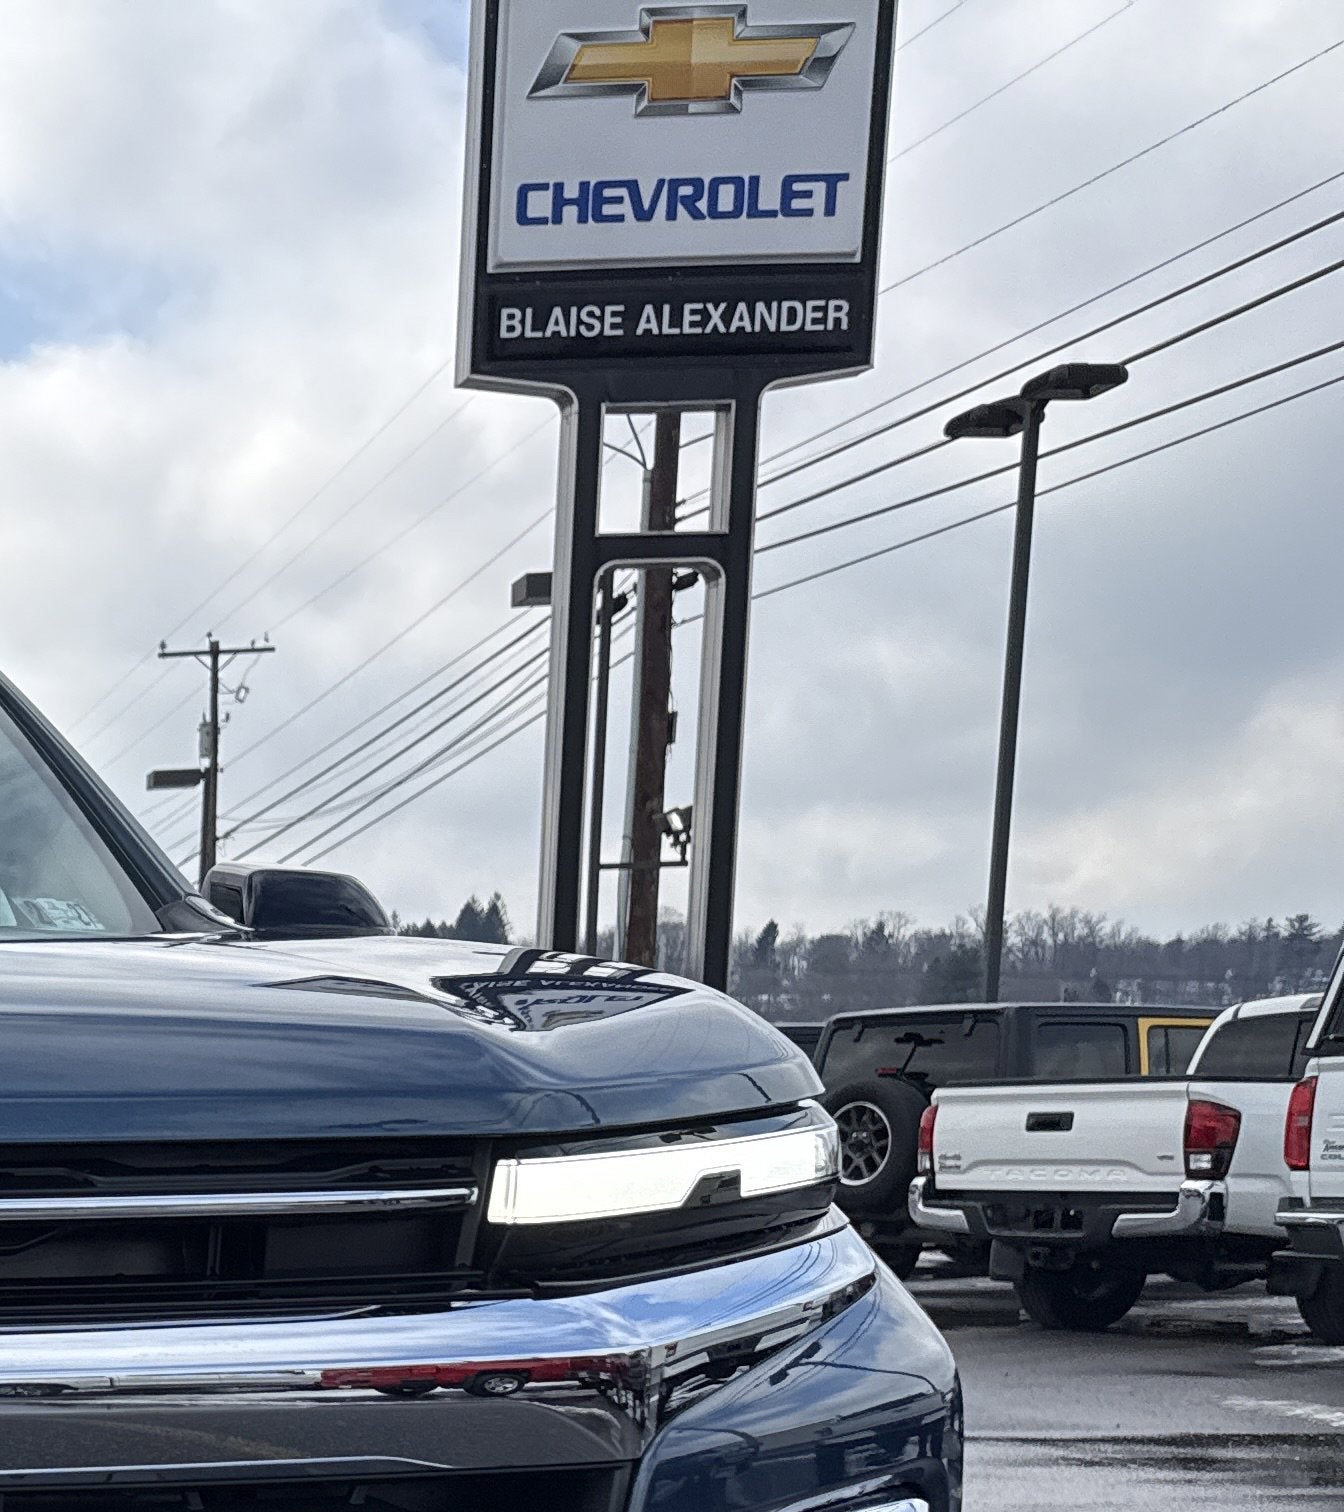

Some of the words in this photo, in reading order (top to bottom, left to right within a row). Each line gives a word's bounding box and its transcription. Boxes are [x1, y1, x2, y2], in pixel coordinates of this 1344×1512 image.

[515, 172, 850, 226] CHEVROLET
[499, 304, 624, 339] BLAISE
[635, 299, 850, 336] ALEXANDER
[986, 1167, 1129, 1181] TACOMA
